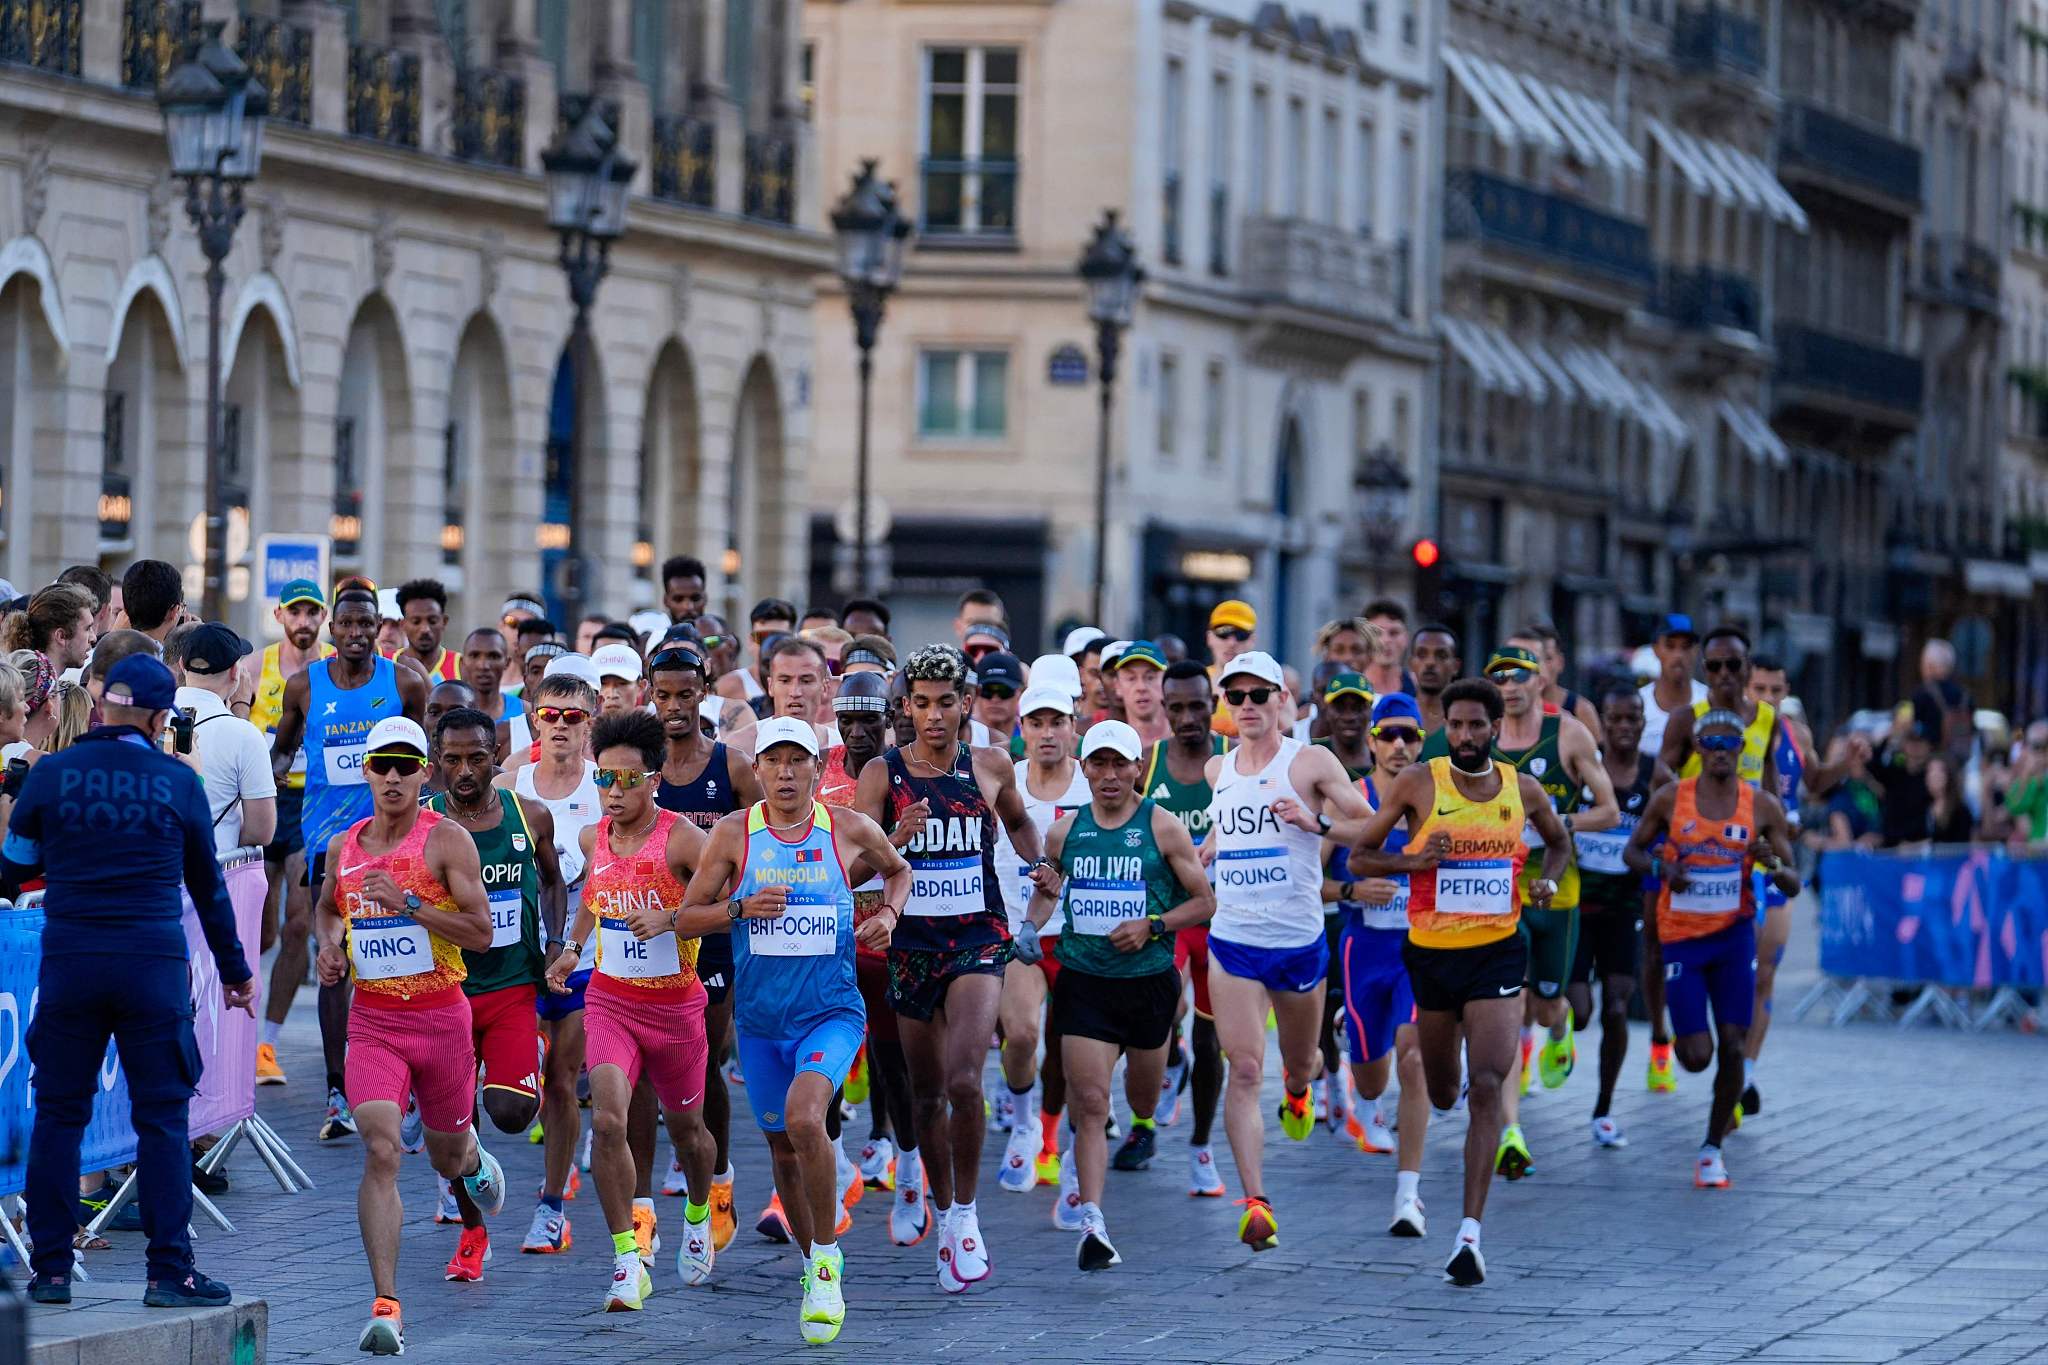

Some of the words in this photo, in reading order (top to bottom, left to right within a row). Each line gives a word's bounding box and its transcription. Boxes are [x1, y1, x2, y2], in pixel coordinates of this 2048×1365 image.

[600, 655, 626, 664] CHINA
[385, 724, 417, 738] CHINA
[1219, 804, 1280, 835] USA
[895, 816, 982, 856] UDAN
[755, 867, 828, 884] MONGOLIA
[1073, 855, 1143, 883] BOLIVIA
[1221, 867, 1287, 886] YOUNG
[1440, 878, 1510, 896] PETROS
[596, 889, 665, 913] CHINA
[1071, 898, 1145, 918] GARIBAY
[750, 916, 836, 936] BAT-OCHIR
[360, 937, 417, 959] YANG
[624, 940, 648, 960] HE
